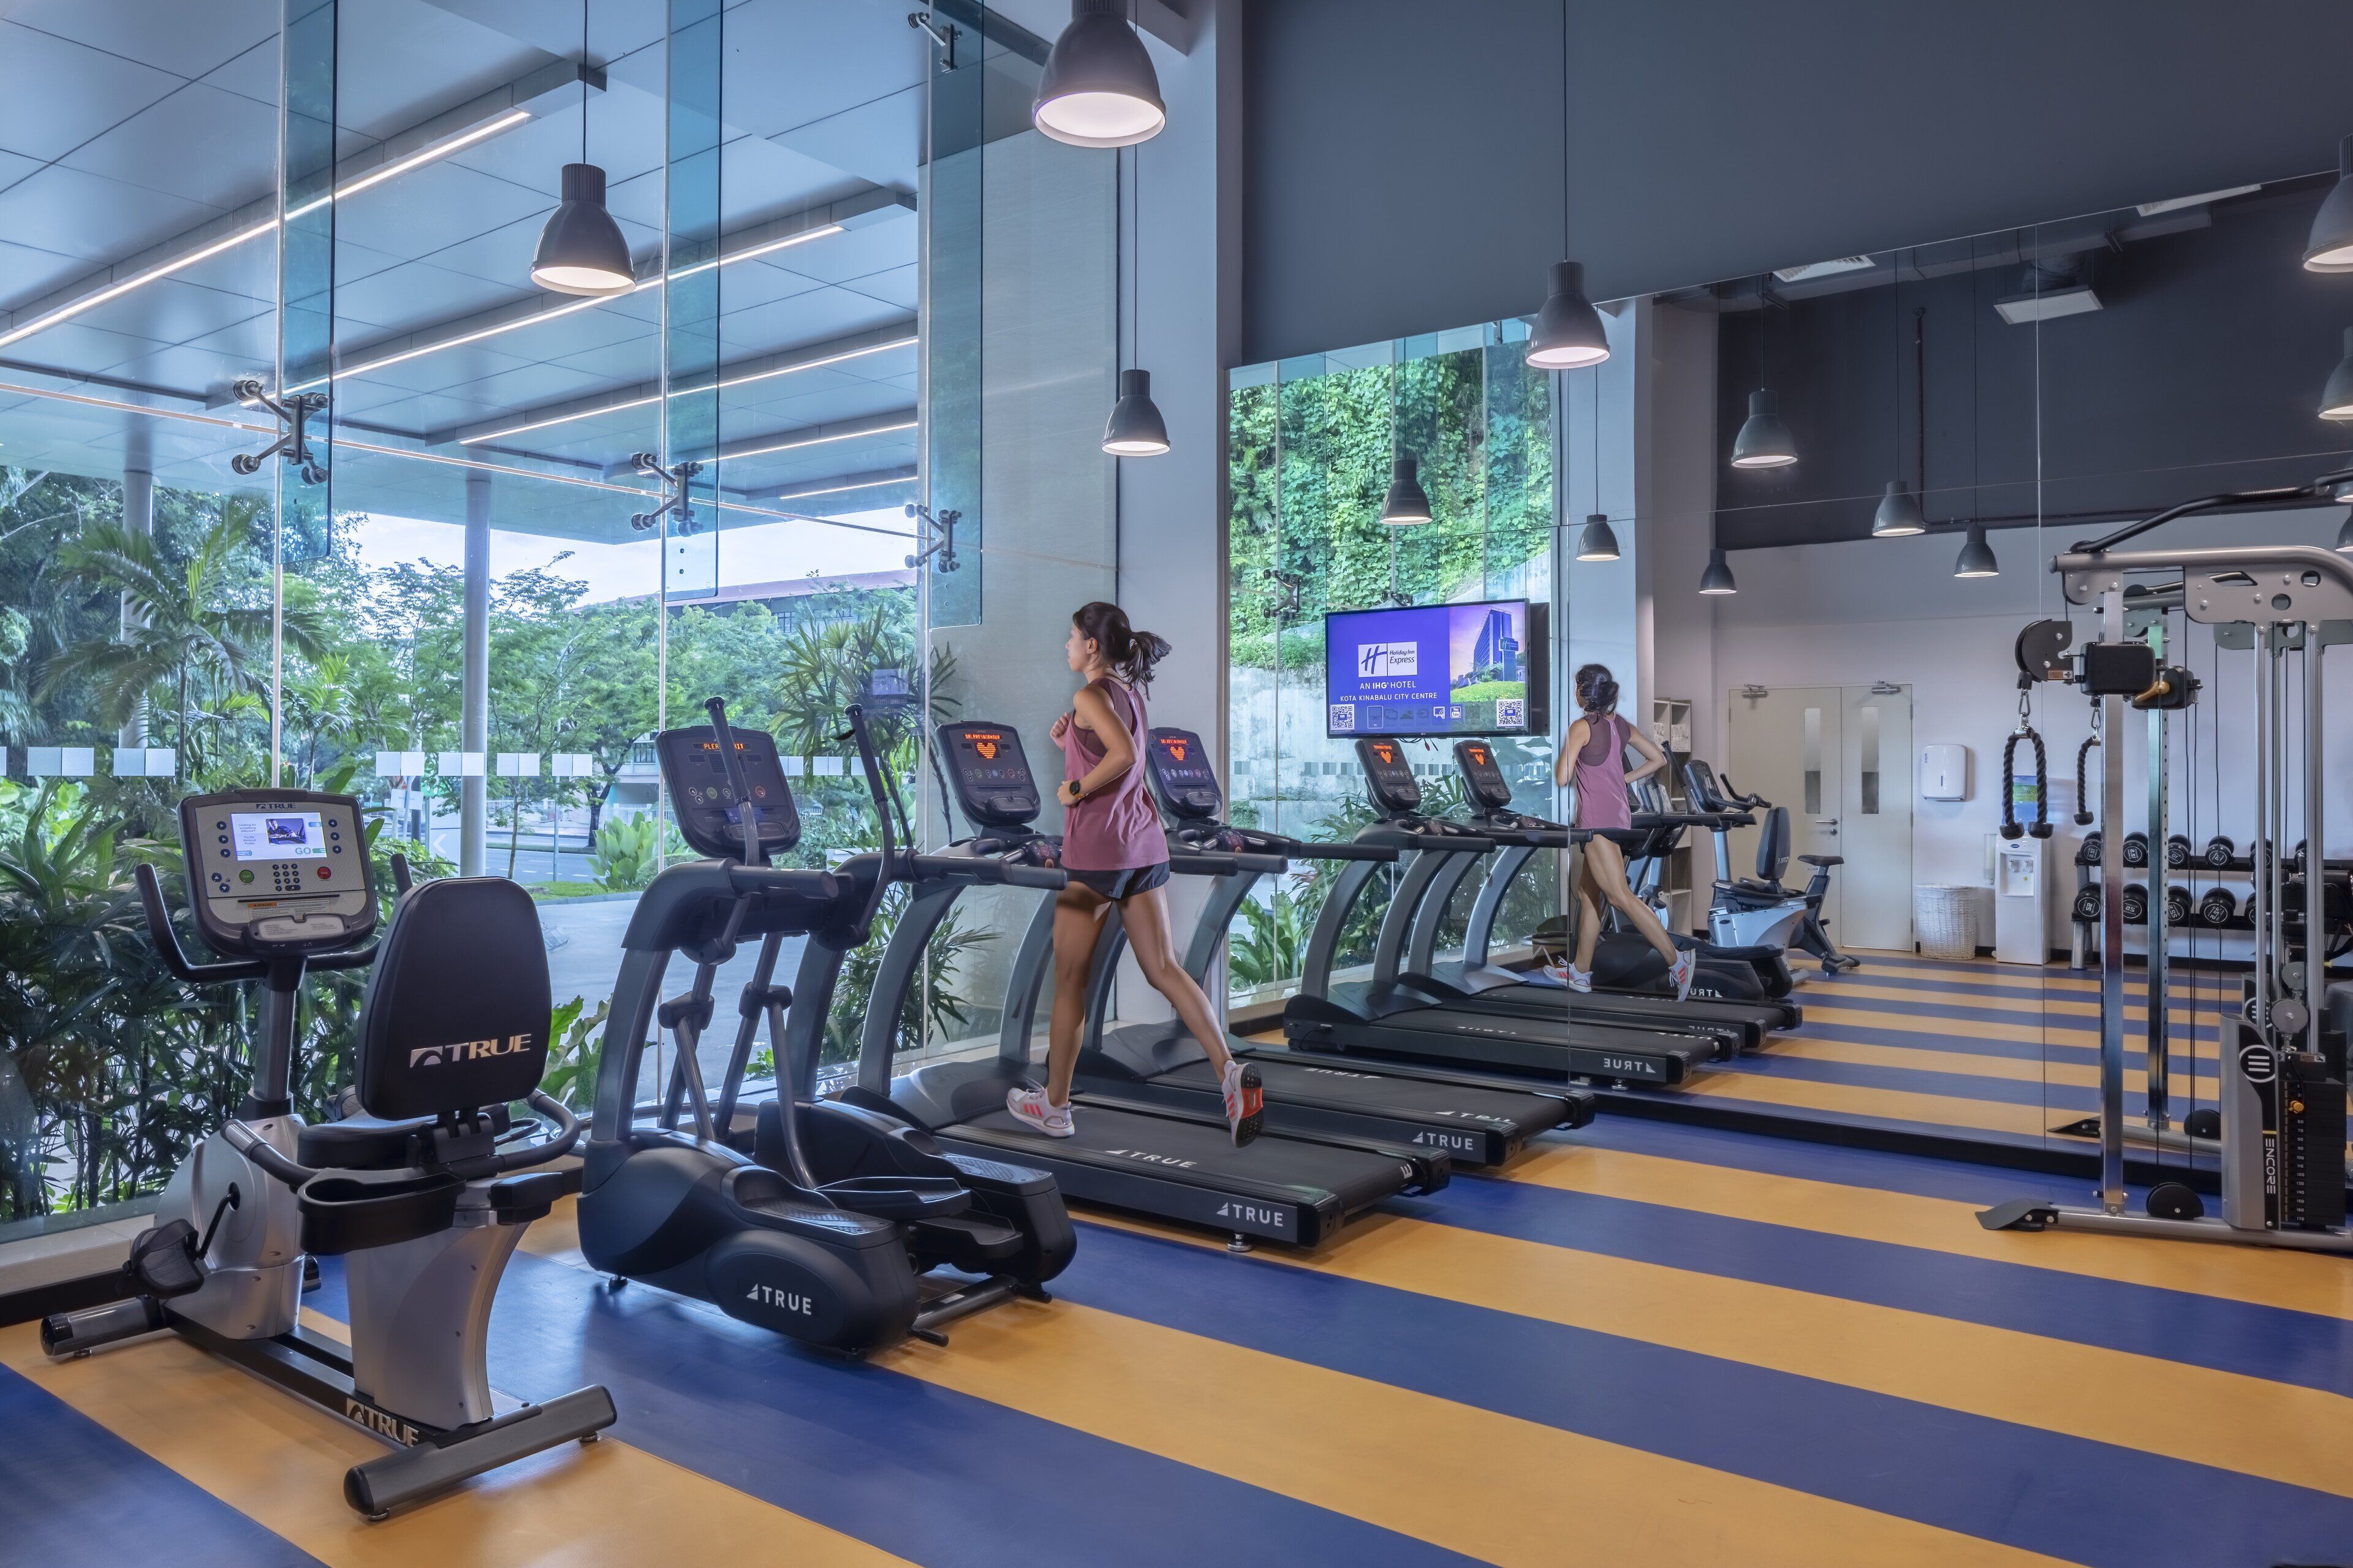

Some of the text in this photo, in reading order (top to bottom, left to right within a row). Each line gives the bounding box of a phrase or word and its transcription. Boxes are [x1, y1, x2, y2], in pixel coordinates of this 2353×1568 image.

[1390, 656, 1415, 665] Express
[445, 1033, 532, 1062] TRUE
[1427, 1132, 1473, 1151] TRUE
[1130, 1151, 1197, 1168] TRUE
[2265, 1138, 2276, 1194] ENCORE
[1232, 1204, 1283, 1227] TRUE
[762, 1286, 811, 1316] TRUE
[365, 1405, 419, 1447] TRUE
